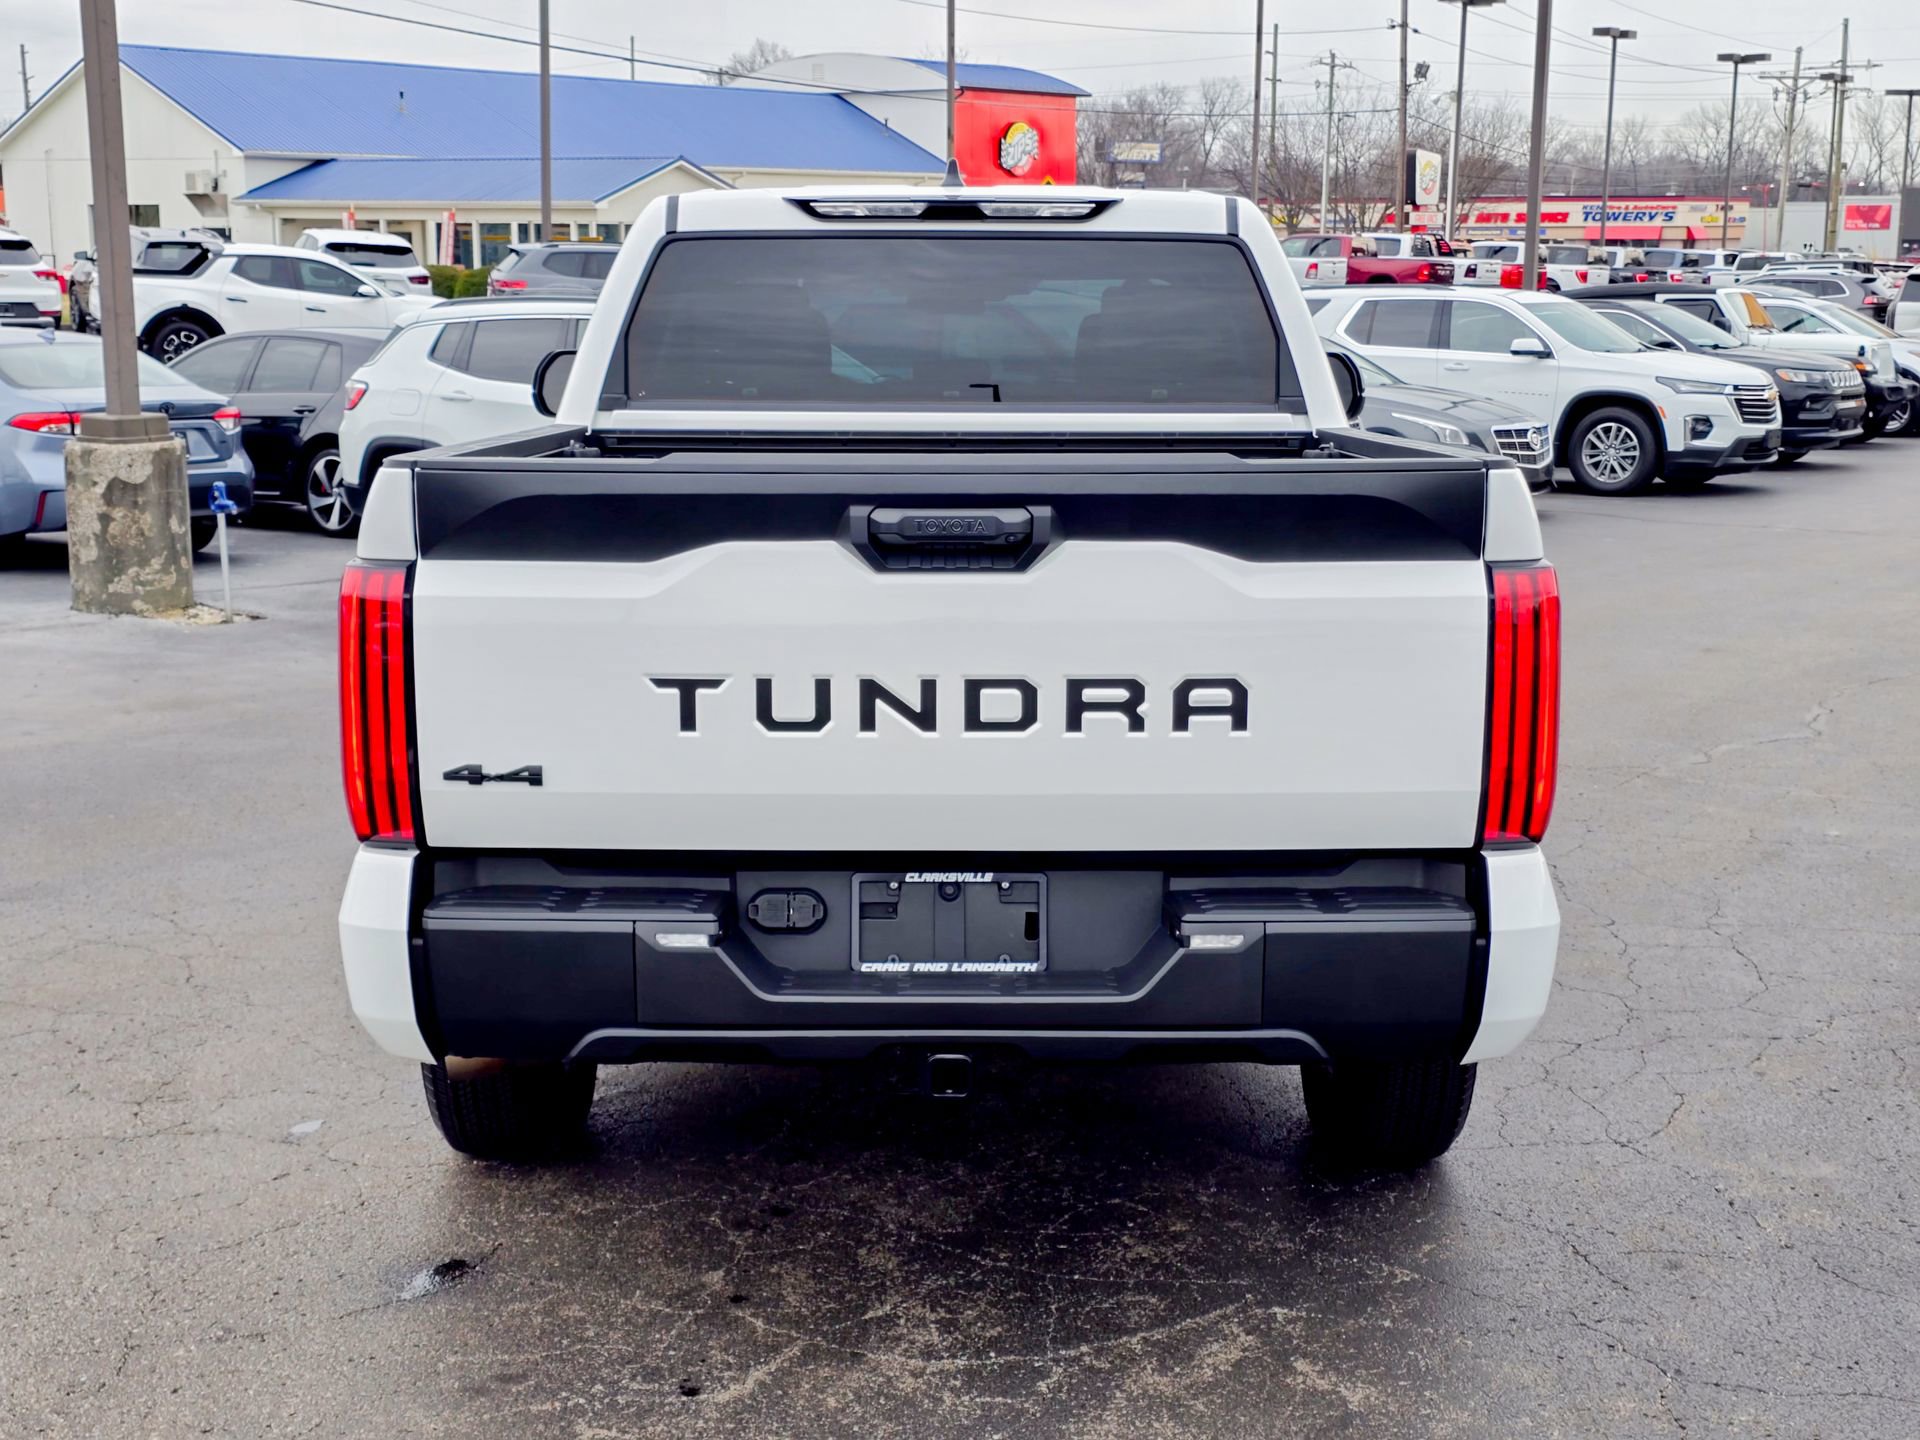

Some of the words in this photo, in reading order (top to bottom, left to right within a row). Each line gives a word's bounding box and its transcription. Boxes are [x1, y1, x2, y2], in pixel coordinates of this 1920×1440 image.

[1513, 212, 1570, 224] SVICE
[1582, 211, 1676, 222] TOWERY'S
[913, 518, 987, 534] TOYOTA
[646, 676, 1251, 735] TUNDRA
[905, 872, 993, 882] CLARKSVILLE
[860, 962, 910, 972] CRAIG
[912, 962, 949, 972] AND
[951, 962, 1038, 972] LANDRETH
